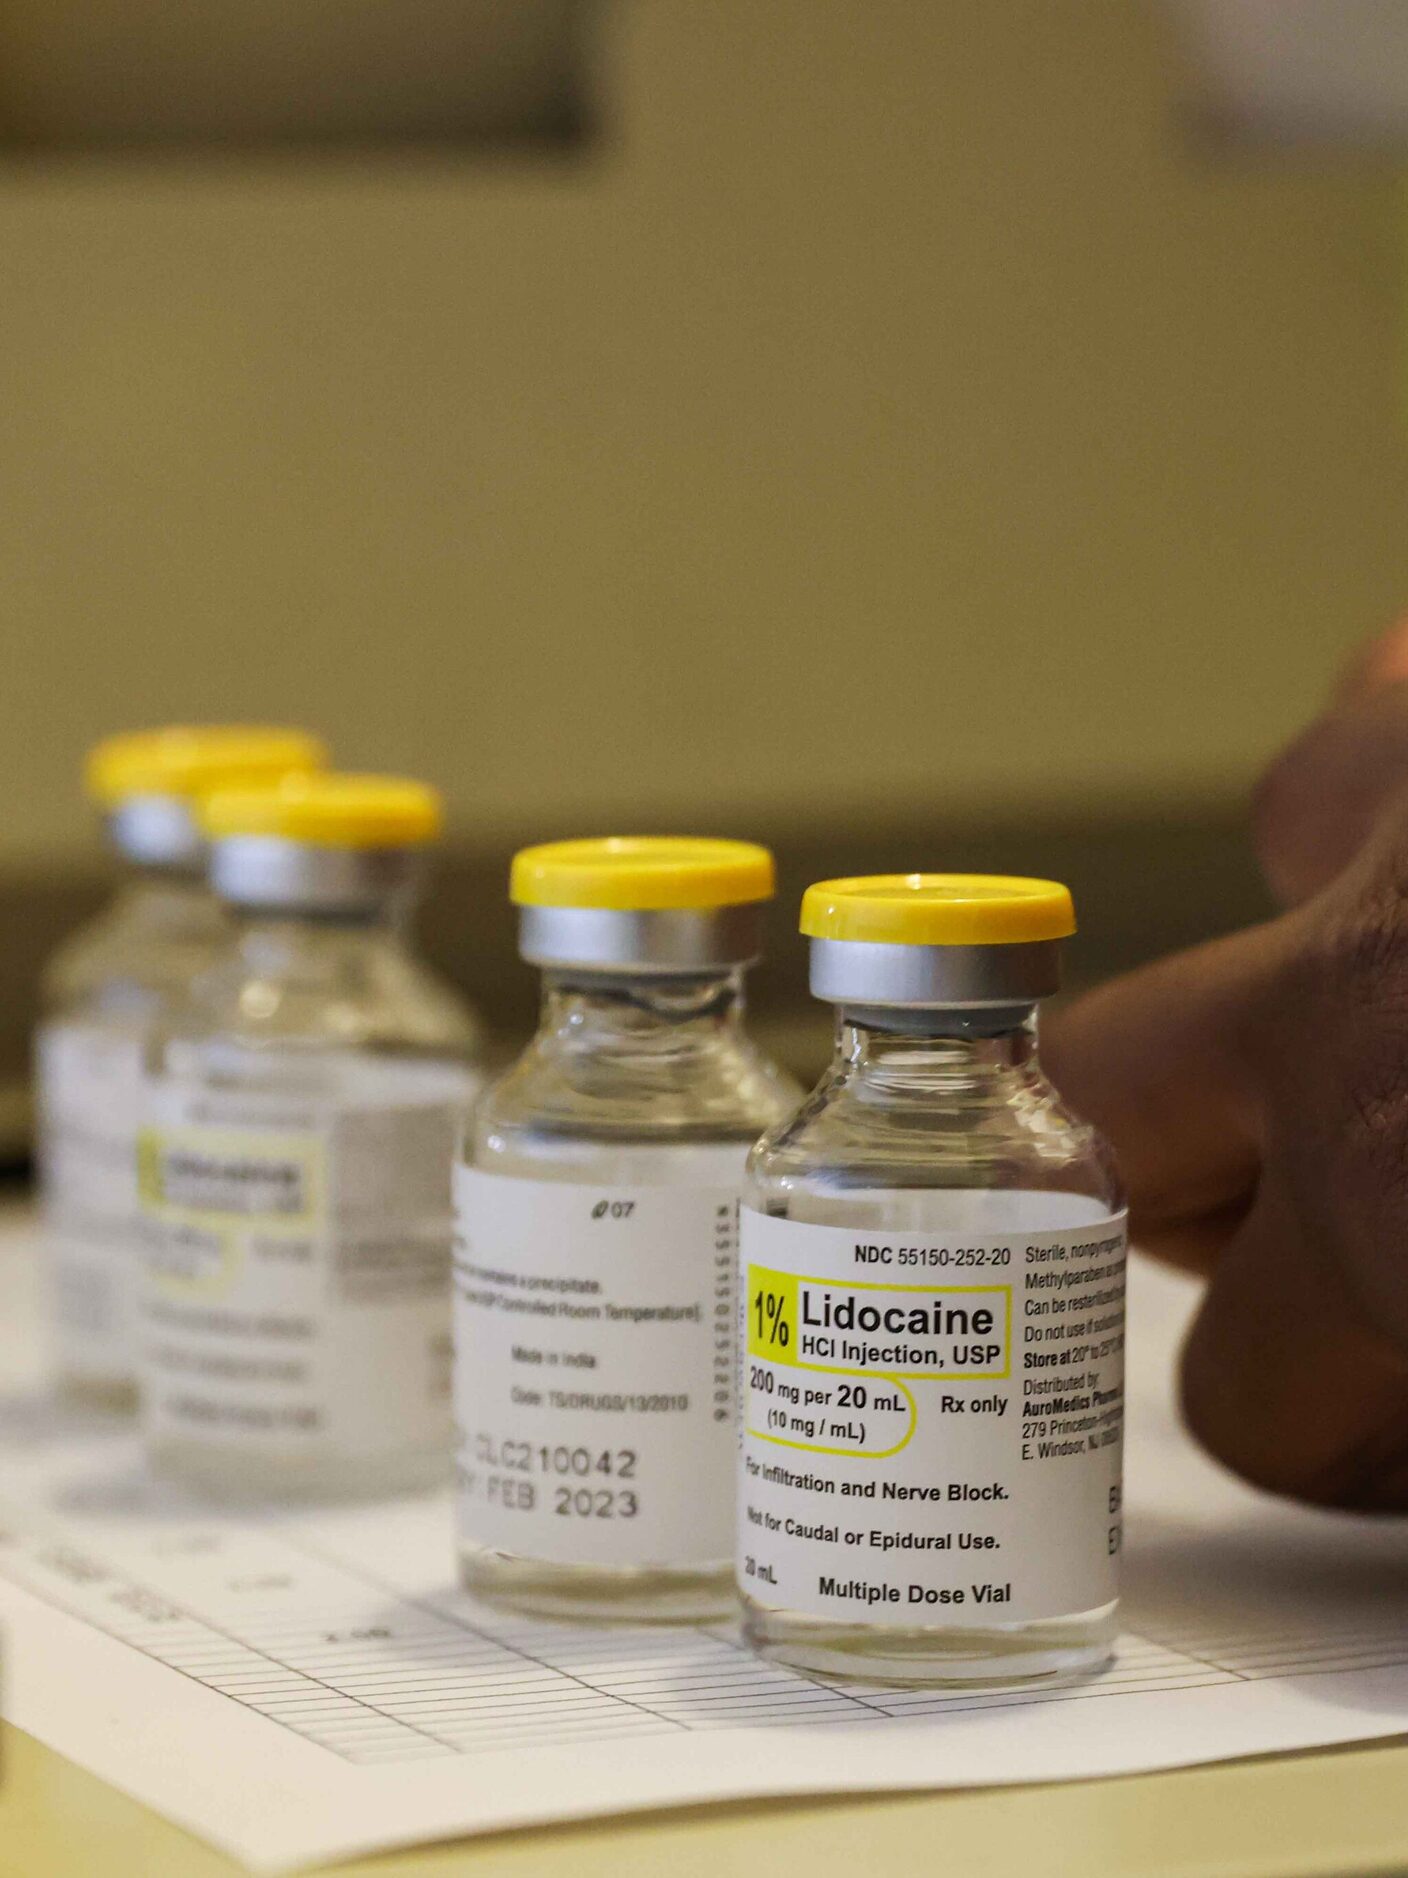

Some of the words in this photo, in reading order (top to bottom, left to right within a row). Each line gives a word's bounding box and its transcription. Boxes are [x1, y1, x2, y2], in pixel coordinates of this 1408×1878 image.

[855, 1245, 893, 1264] NDC
[898, 1248, 1011, 1266] 55150-252-20
[1025, 1245, 1069, 1263] Sterile,
[558, 1301, 600, 1319] Room
[755, 1290, 789, 1347] 1%
[803, 1290, 994, 1336] Lidocaine
[1024, 1299, 1049, 1317] Can
[1052, 1298, 1066, 1314] be
[1024, 1326, 1043, 1342] Do
[1045, 1324, 1065, 1340] not
[1066, 1322, 1085, 1337] use
[802, 1334, 835, 1358] HCl
[842, 1340, 944, 1367] Injection,
[953, 1345, 1001, 1365] USP
[1024, 1350, 1058, 1369] Store
[1060, 1349, 1071, 1365] at
[750, 1366, 774, 1394] 200
[777, 1384, 799, 1404] mg
[804, 1390, 832, 1406] per
[837, 1384, 867, 1409] 20
[873, 1395, 906, 1412] mL
[1023, 1373, 1085, 1396] Distributed
[941, 1396, 965, 1413] Rx
[970, 1396, 1008, 1416] only
[1022, 1395, 1090, 1418] AuroMedics
[767, 1408, 786, 1429] (10
[790, 1417, 815, 1438] mg
[830, 1422, 866, 1444] mL)
[1022, 1421, 1047, 1440] 279
[1022, 1444, 1034, 1461] E.
[1038, 1440, 1086, 1459] Windsor,
[763, 1463, 835, 1494] Infiltration
[841, 1481, 876, 1498] and
[882, 1483, 941, 1500] Nerve
[947, 1484, 1009, 1501] Block.
[487, 1475, 536, 1511] FEB
[555, 1486, 639, 1519] 2023
[765, 1513, 781, 1531] for
[784, 1518, 839, 1543] Caudal
[844, 1532, 864, 1545] or
[869, 1530, 951, 1551] Epidural
[958, 1533, 1001, 1550] Use.
[757, 1565, 777, 1585] mL
[819, 1577, 900, 1605] Multiple
[908, 1585, 965, 1604] Dose
[971, 1583, 1011, 1603] Vial
